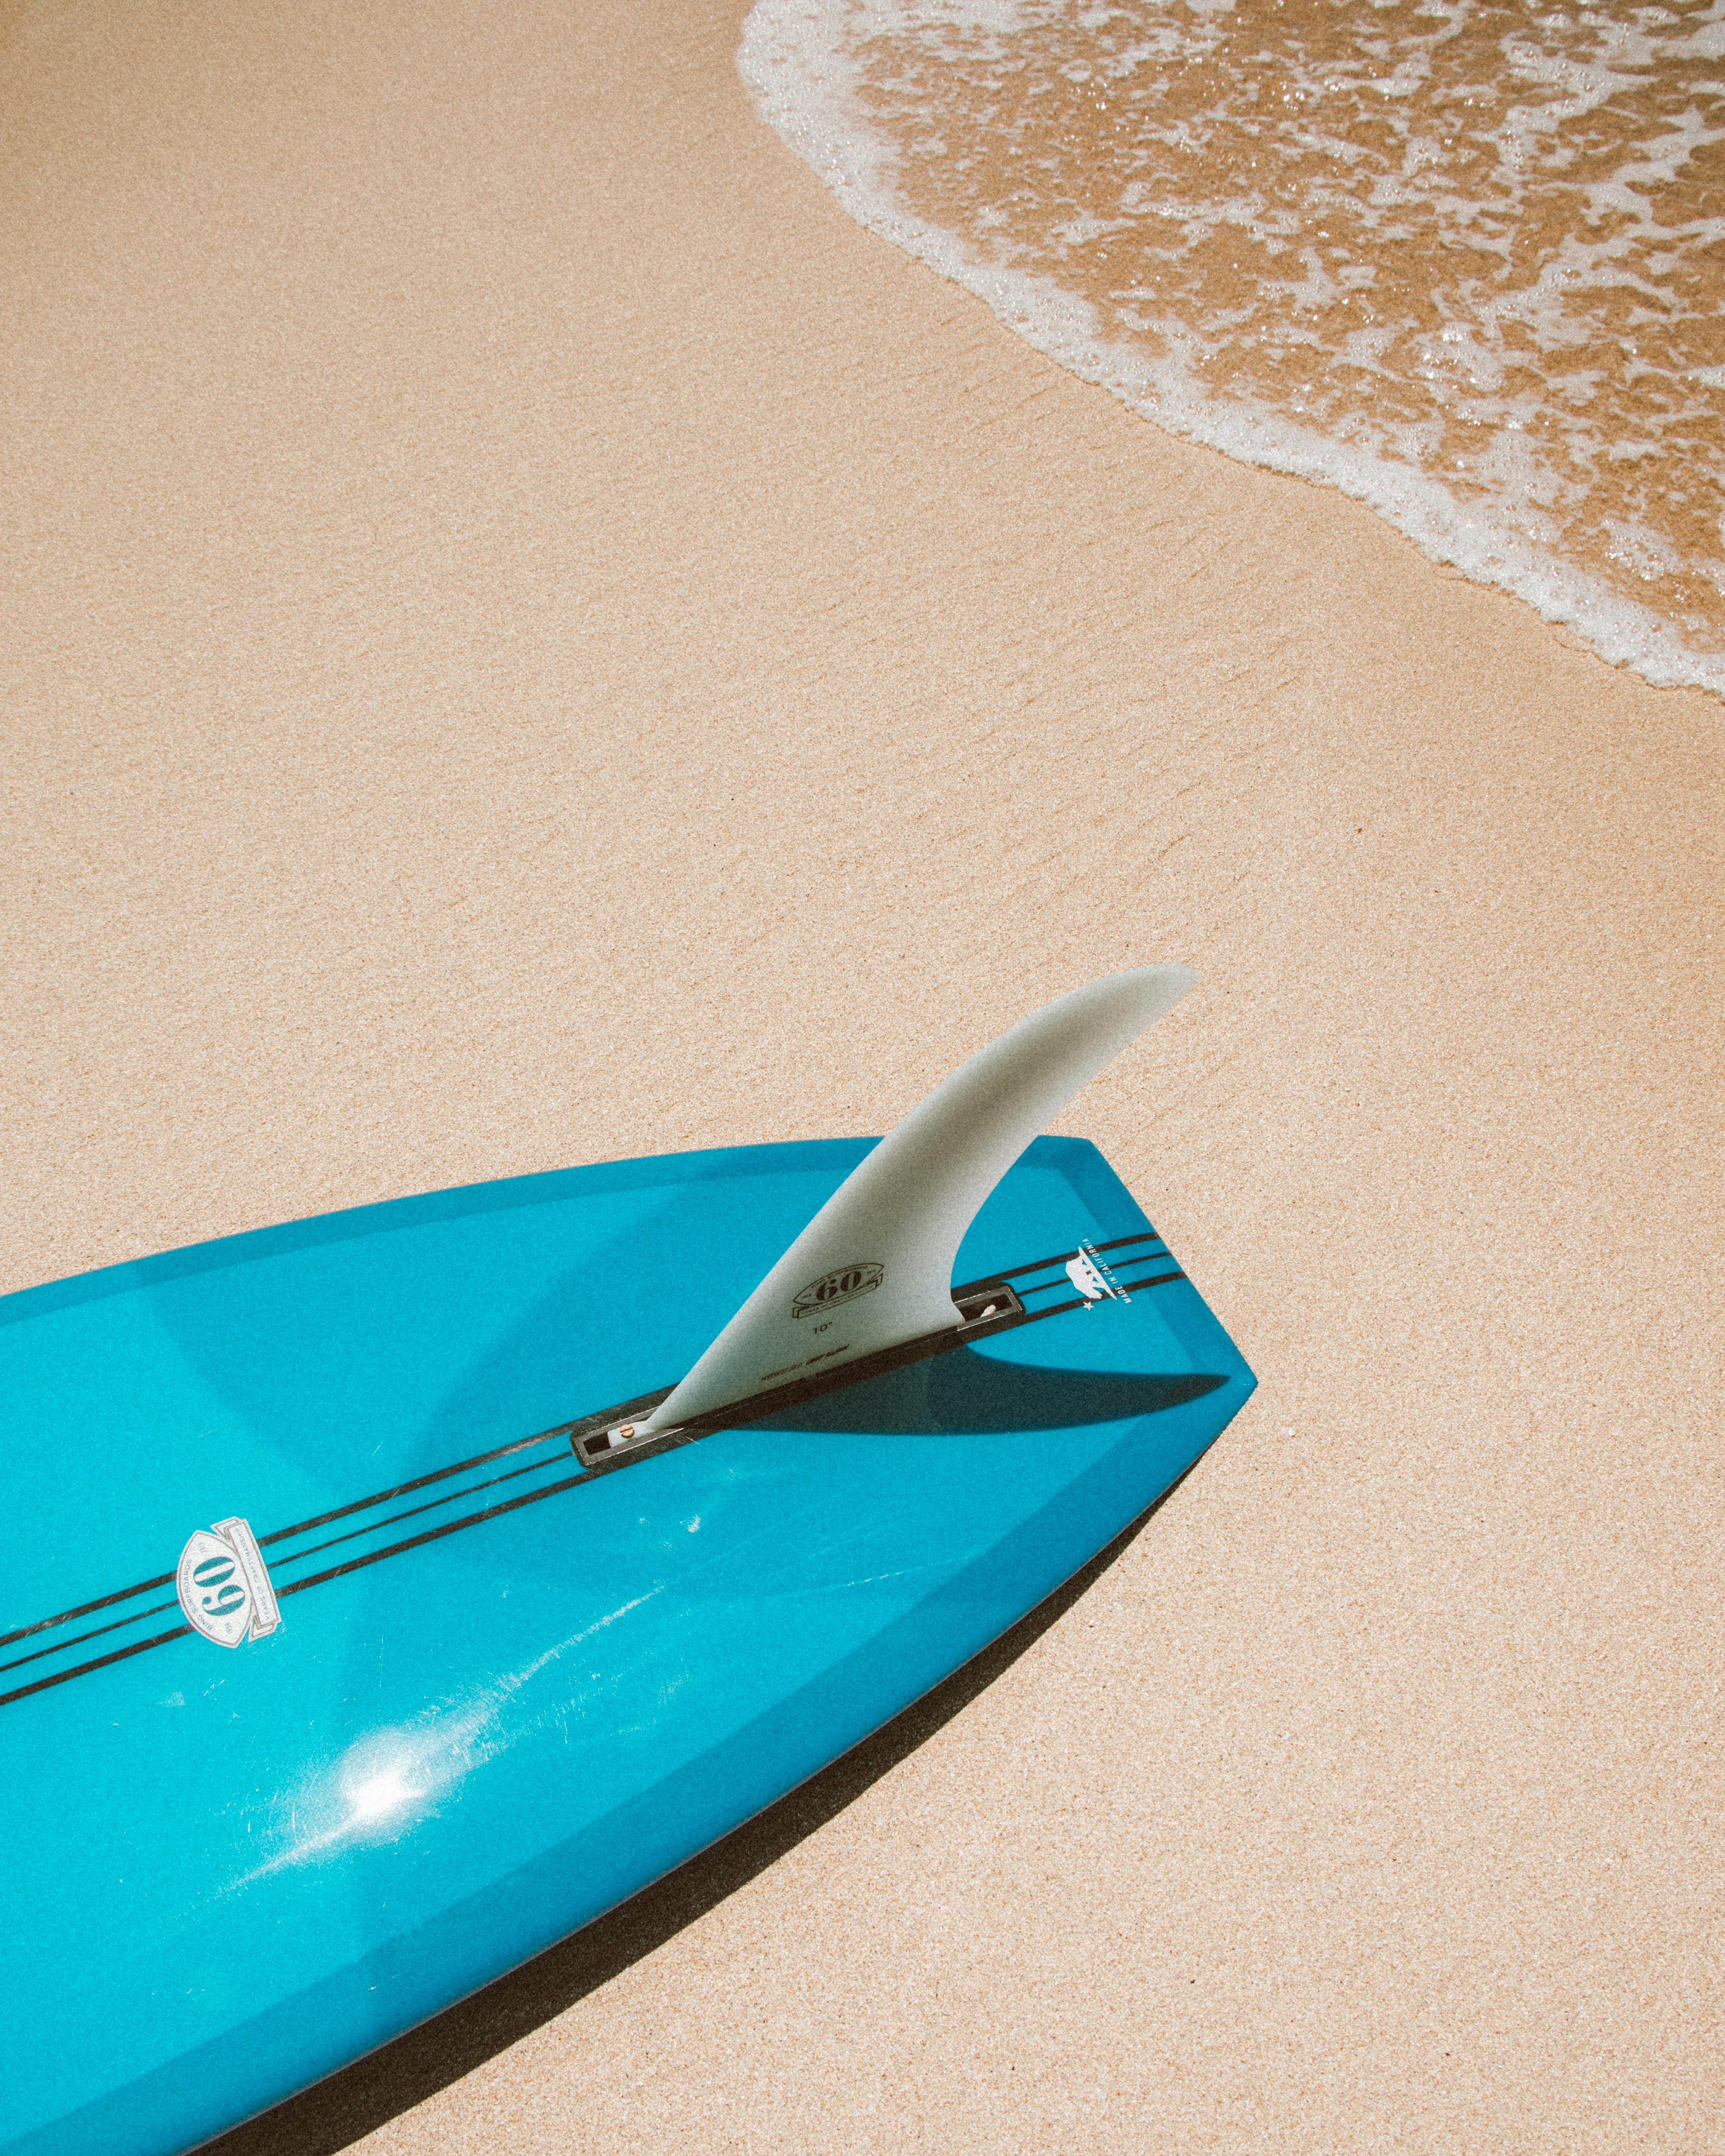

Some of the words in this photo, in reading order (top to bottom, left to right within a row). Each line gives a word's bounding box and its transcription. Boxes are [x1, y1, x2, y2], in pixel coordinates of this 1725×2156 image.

[1082, 1239, 1112, 1275] CALIFORNIA
[817, 1271, 862, 1301] 60
[1108, 1276, 1118, 1284] IN
[1115, 1285, 1132, 1304] MADE
[814, 1321, 833, 1334] 10"
[234, 1528, 260, 1583] CRAFTSMANSHIP
[184, 1559, 198, 1614] SURFBOARDS
[193, 1556, 245, 1616] 60
[257, 1586, 264, 1595] OF
[261, 1596, 270, 1619] YEARS
[196, 1614, 213, 1631] BING
